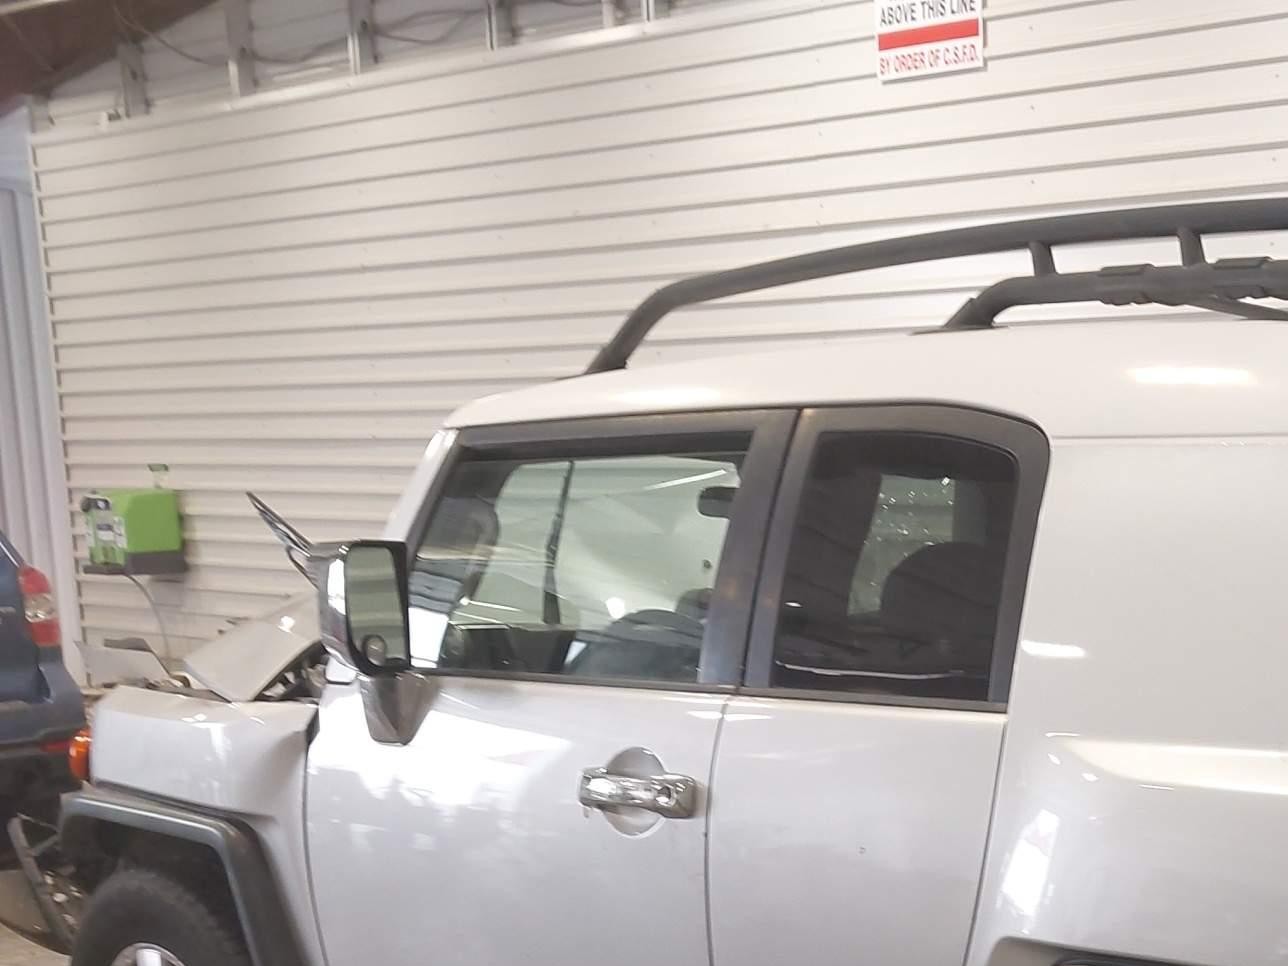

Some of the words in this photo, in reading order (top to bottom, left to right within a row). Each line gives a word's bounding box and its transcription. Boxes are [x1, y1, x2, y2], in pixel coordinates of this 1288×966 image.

[880, 3, 916, 26] ABOVE
[921, 0, 946, 20] THIS
[951, 0, 976, 16] LINE
[894, 52, 926, 73] ORDER
[928, 49, 940, 68] OF
